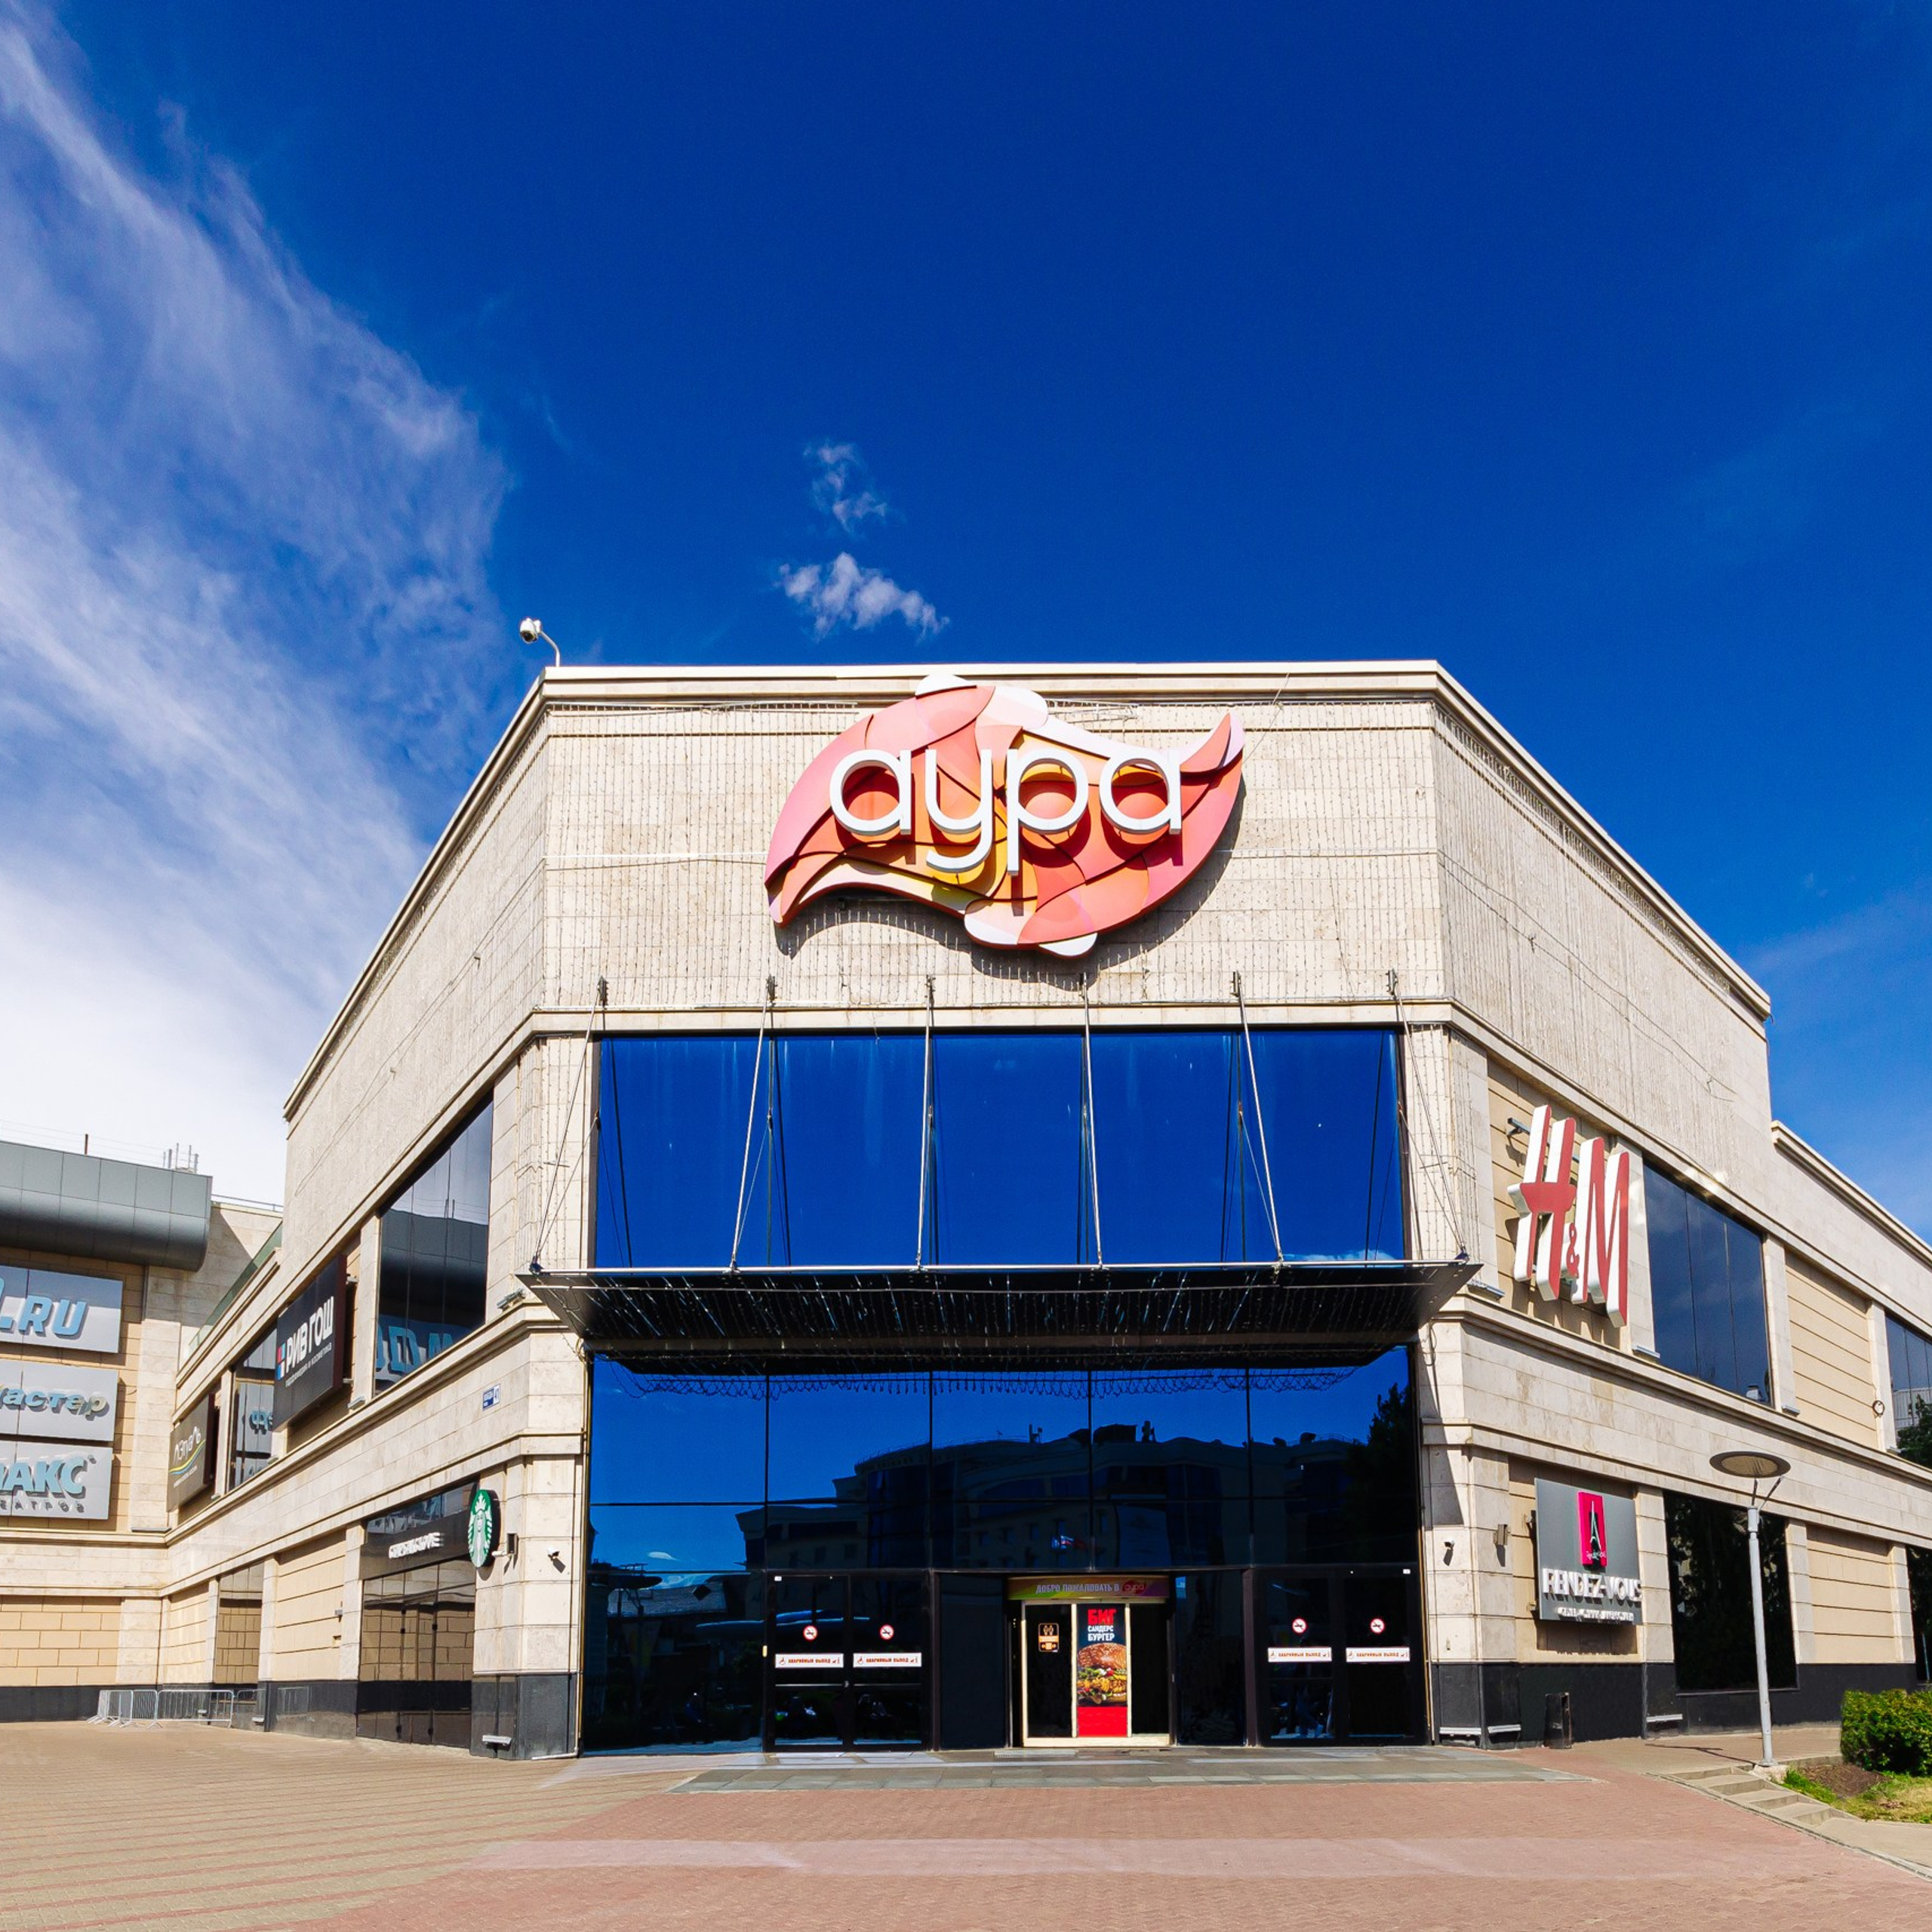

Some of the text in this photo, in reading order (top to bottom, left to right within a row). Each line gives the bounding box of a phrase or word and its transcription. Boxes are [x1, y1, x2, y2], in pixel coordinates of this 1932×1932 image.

[829, 749, 1183, 875] аура
[1508, 1105, 1629, 1329] H&M
[0, 1277, 88, 1336] .RU
[286, 1321, 309, 1374] РИВ
[308, 1296, 334, 1353] ГОШ
[0, 1386, 108, 1417] астер
[1035, 1583, 1060, 1595] ДОБРО
[1063, 1583, 1112, 1593] ПОЖАЛОВАТЬ
[1542, 1567, 1643, 1602] RENDEZ-VOUS
[1088, 1608, 1116, 1626] БИГ
[1088, 1625, 1114, 1633] САНДЕРС
[1088, 1633, 1115, 1641] БУРГЕР
